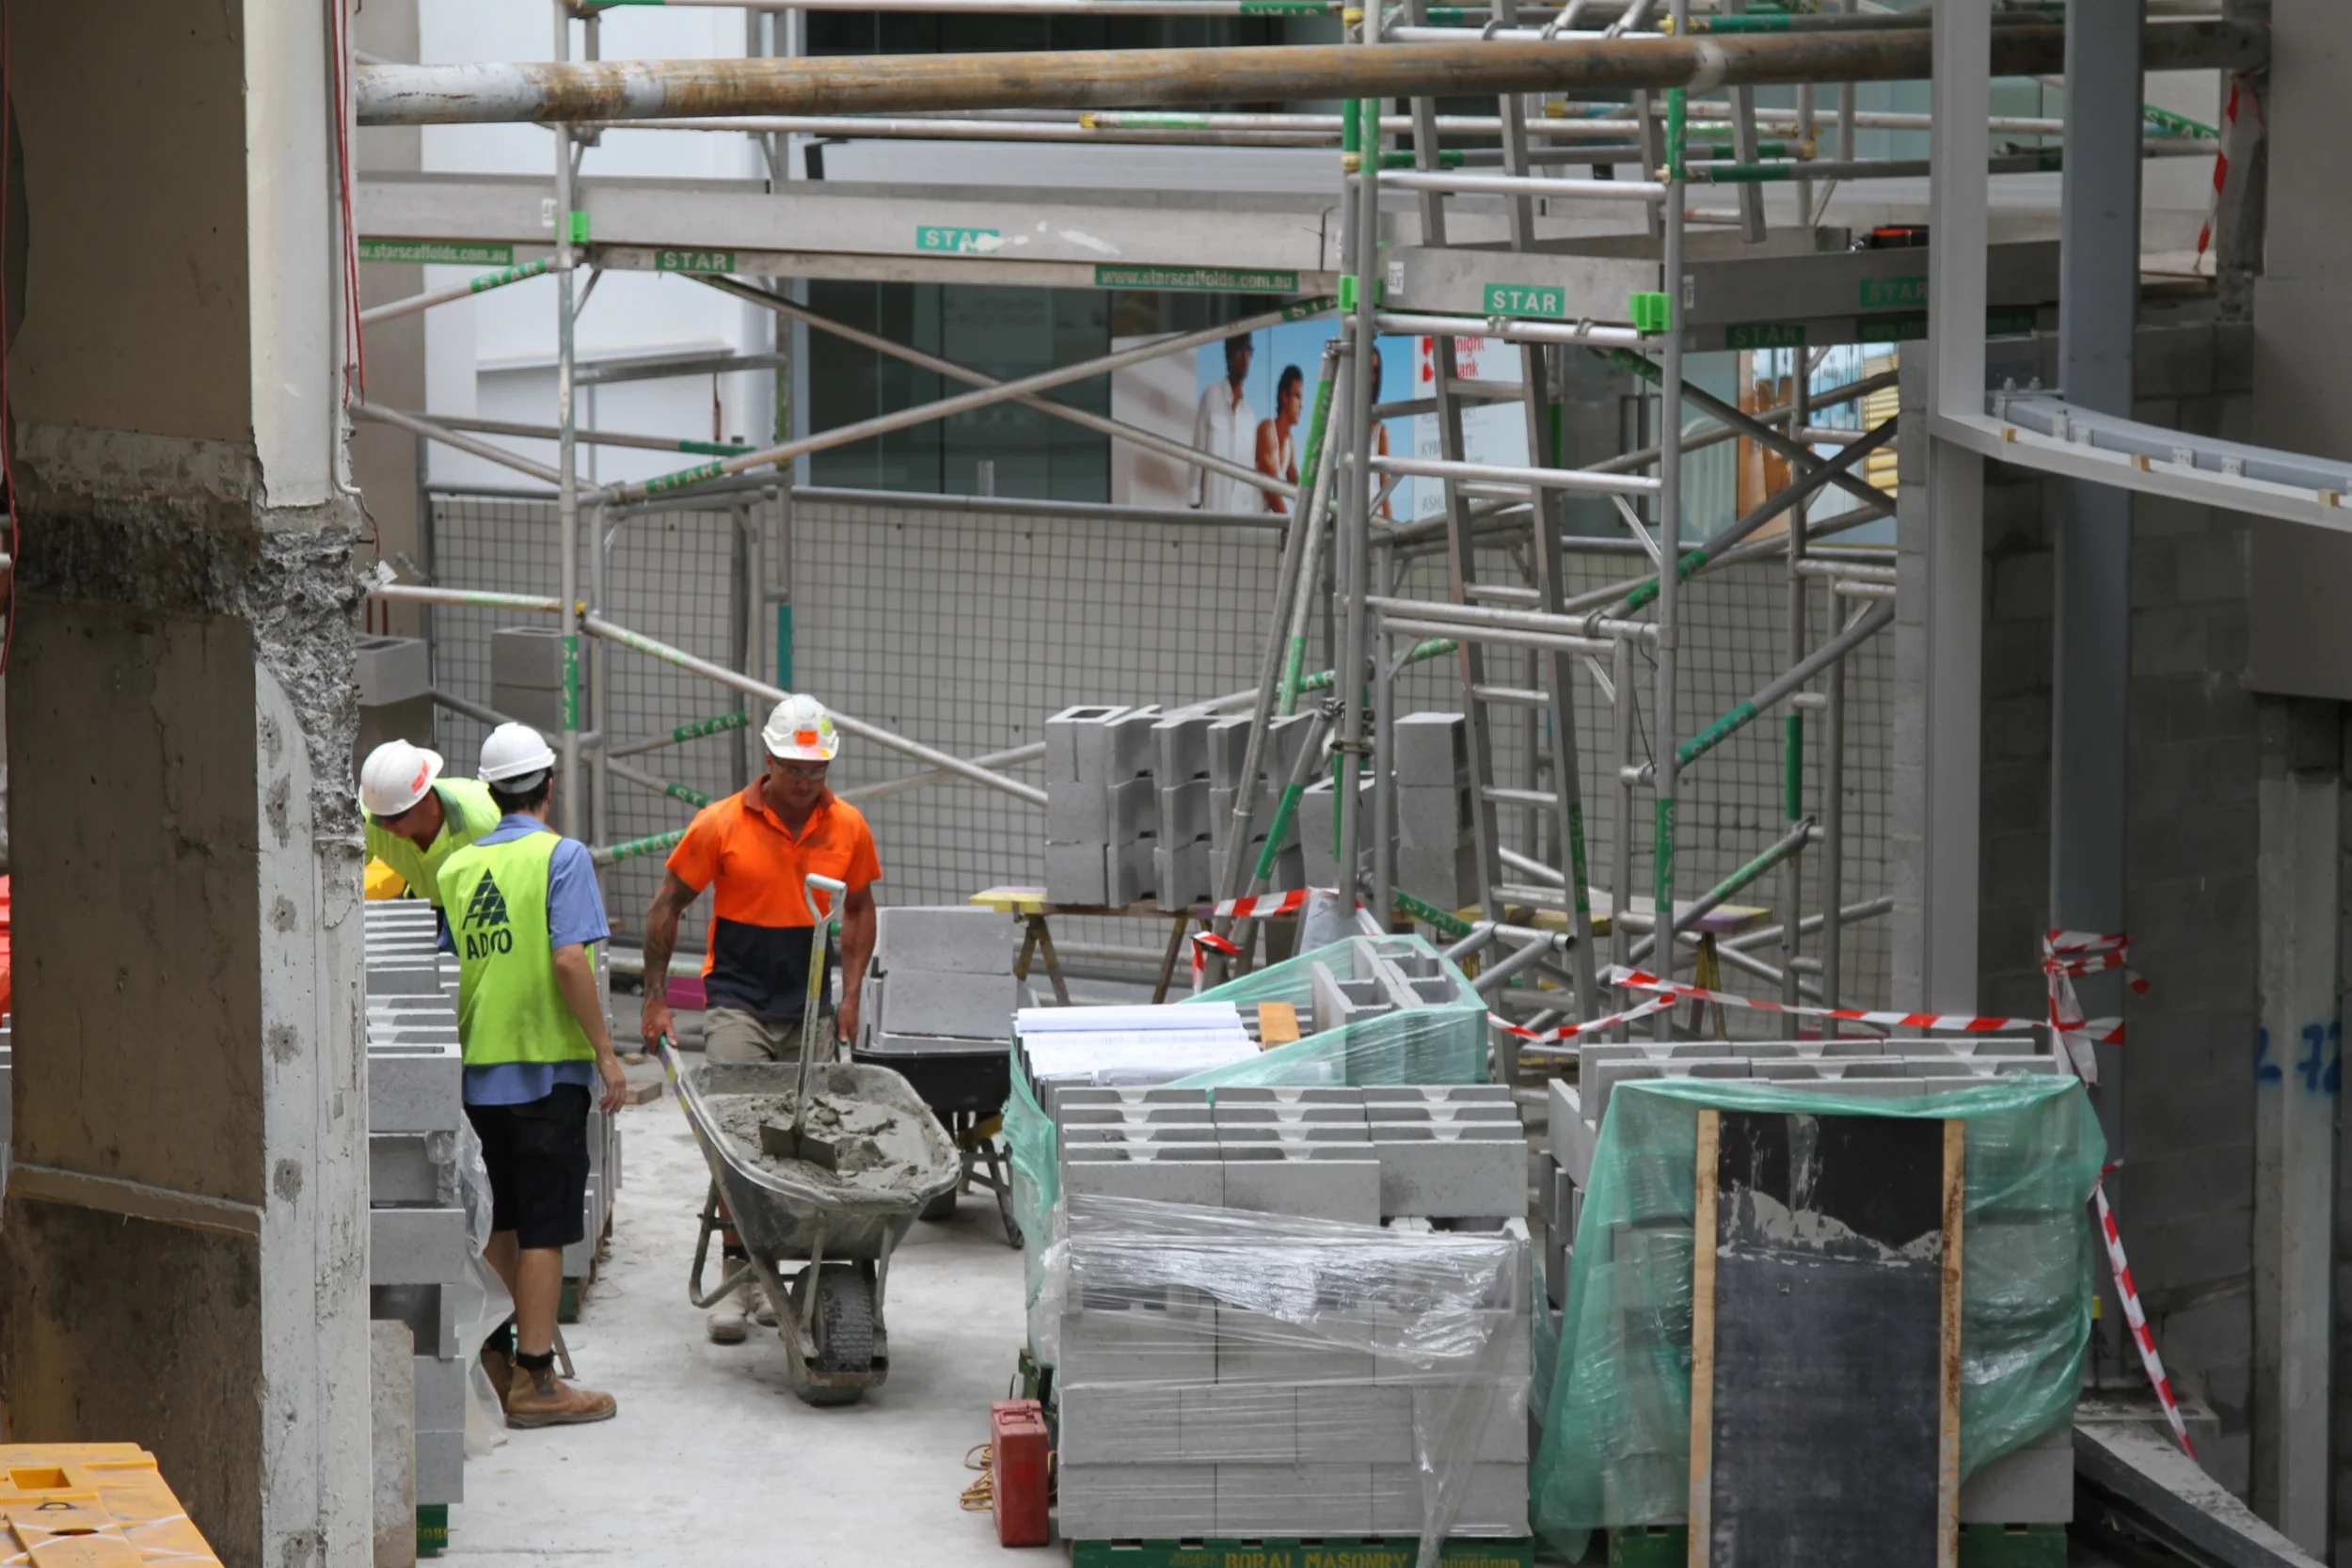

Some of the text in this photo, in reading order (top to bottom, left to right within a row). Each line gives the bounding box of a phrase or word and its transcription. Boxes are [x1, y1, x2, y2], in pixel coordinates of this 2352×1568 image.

[925, 229, 993, 249] STA
[359, 243, 508, 261] w.starscaffolds.com.au
[663, 250, 727, 271] STAR
[1492, 290, 1557, 313] STAR
[1734, 325, 1798, 346] STAR
[1454, 336, 1485, 357] night
[655, 465, 715, 491] STAR
[682, 714, 739, 736] STAR
[621, 831, 681, 854] STAR
[466, 927, 513, 961] ADCO
